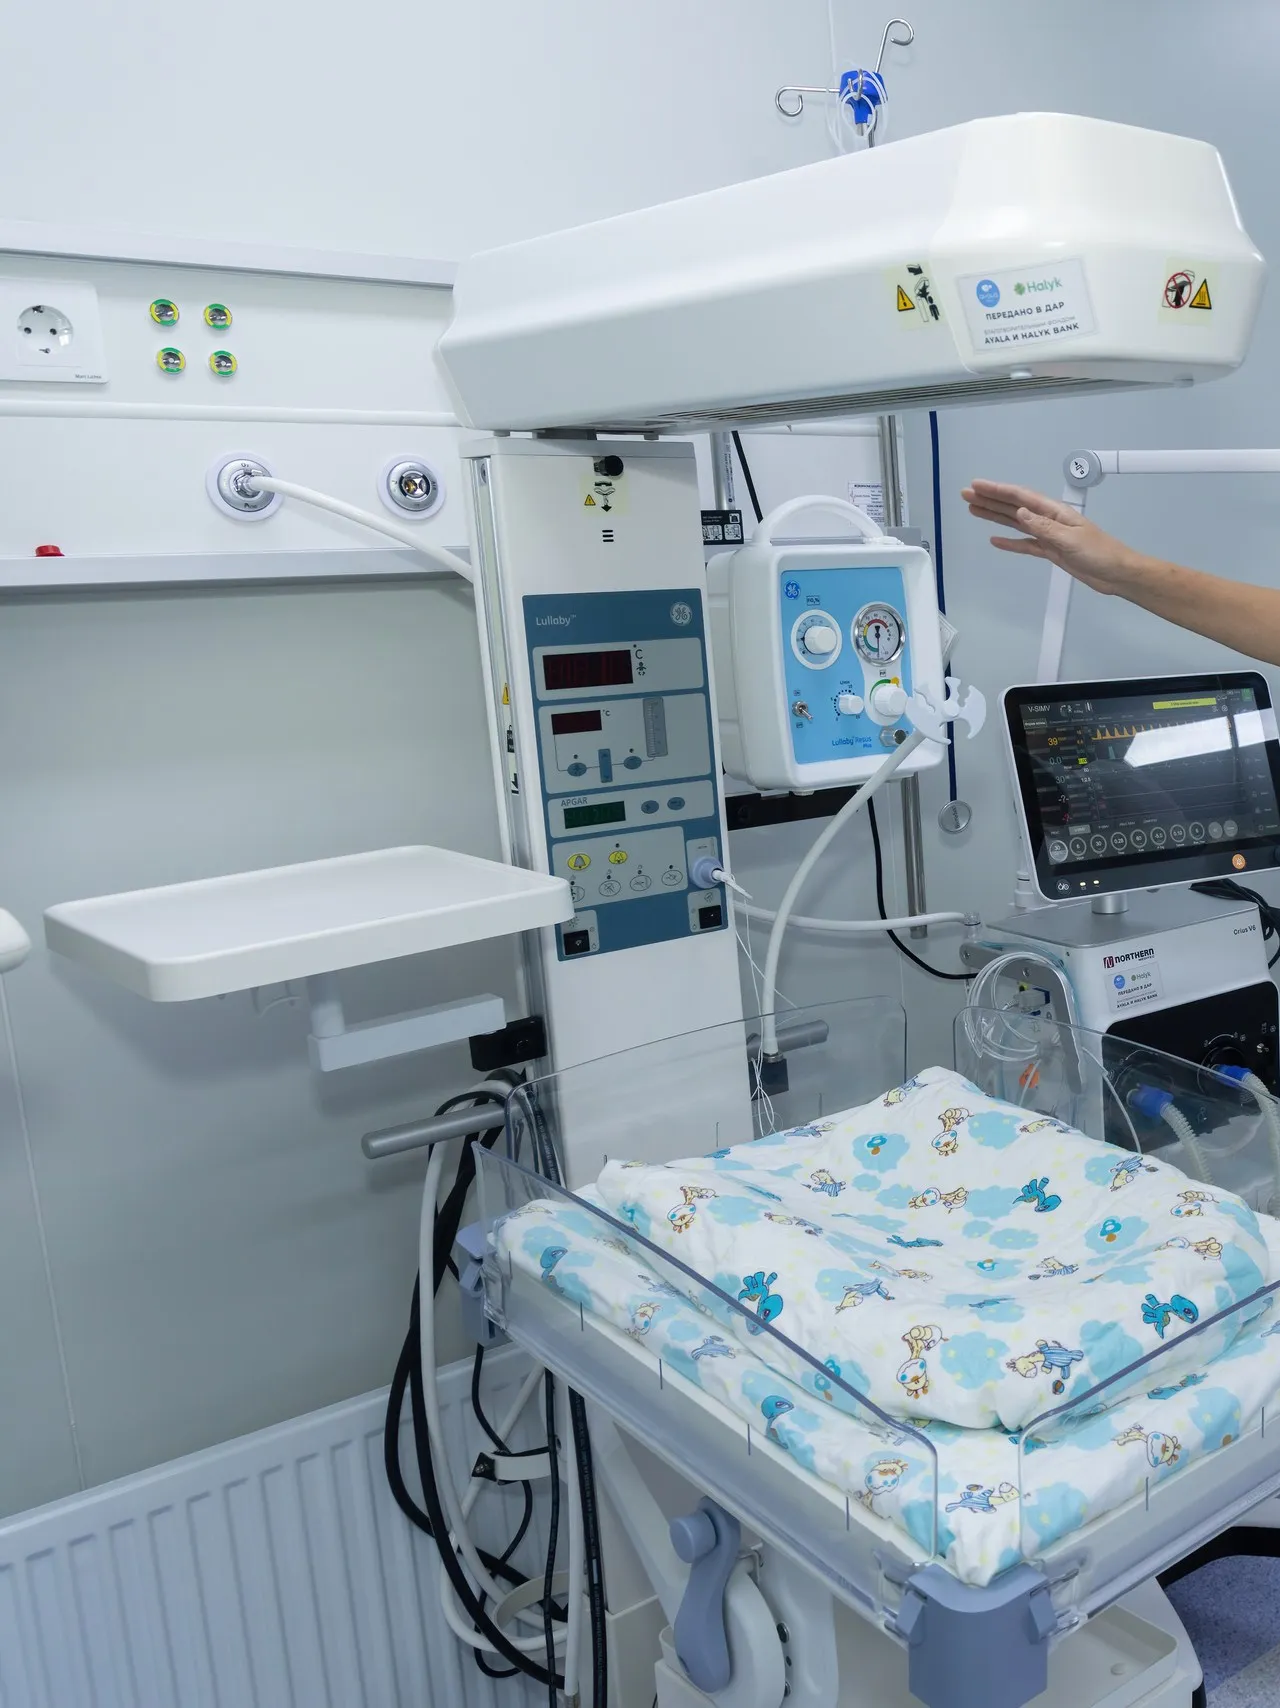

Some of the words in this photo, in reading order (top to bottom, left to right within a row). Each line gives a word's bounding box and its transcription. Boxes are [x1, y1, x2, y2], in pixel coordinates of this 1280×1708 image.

[1026, 278, 1062, 293] Halyk
[986, 307, 1033, 320] ПЕРЕДАНО
[1036, 306, 1042, 314] В
[1045, 302, 1064, 312] ДАР
[984, 334, 1010, 344] AYALA
[1012, 332, 1019, 341] И
[1021, 328, 1050, 340] HALYK
[1054, 322, 1080, 334] BANK
[1048, 738, 1058, 746] 39
[560, 796, 588, 807] APGAR
[1233, 926, 1248, 935] Crius
[1114, 948, 1154, 964] NORTHERN
